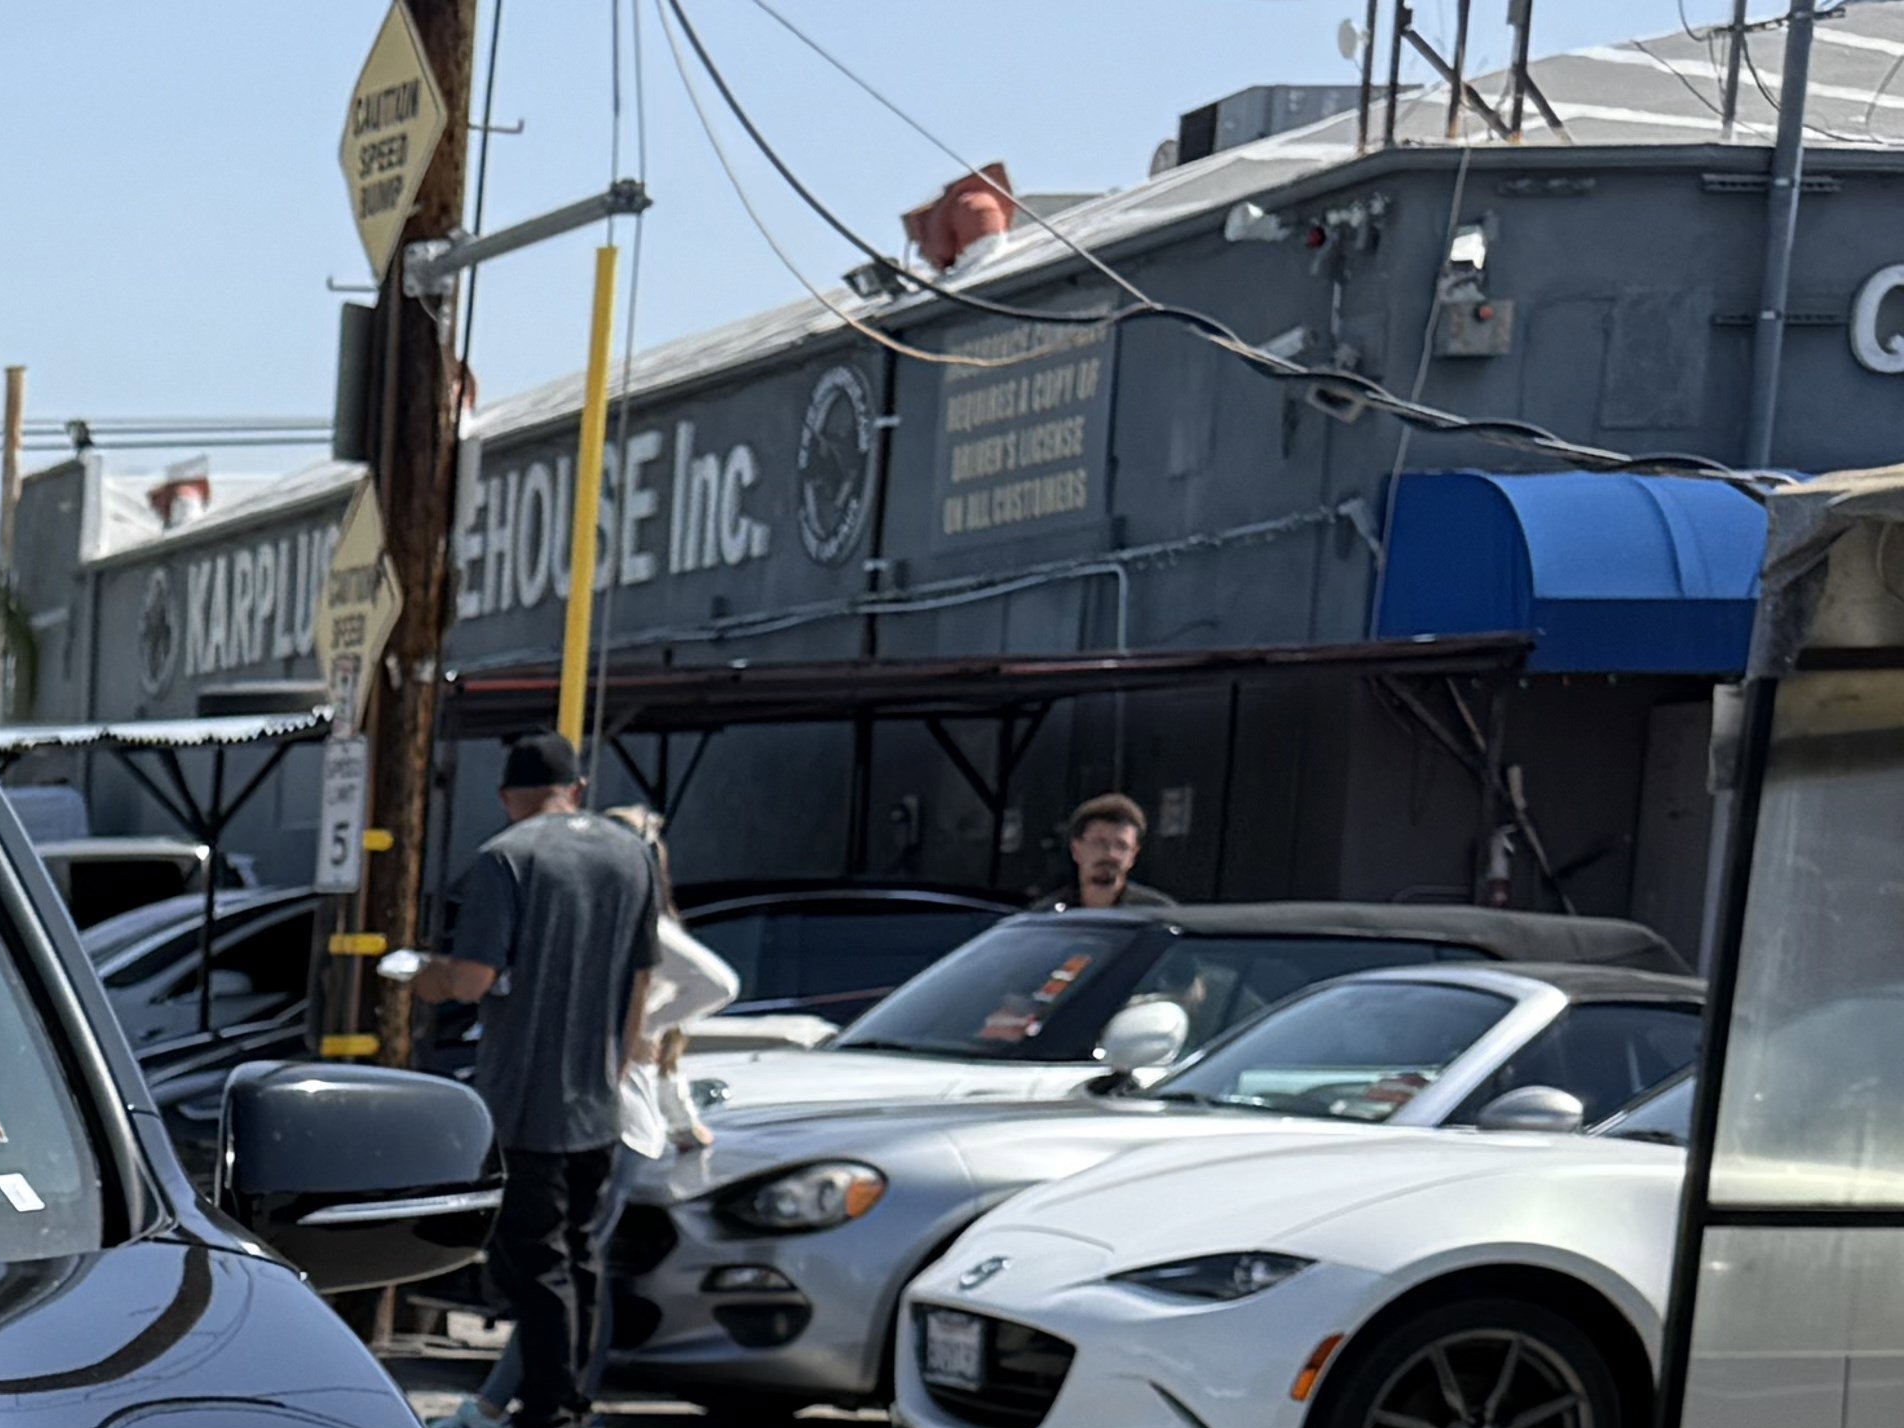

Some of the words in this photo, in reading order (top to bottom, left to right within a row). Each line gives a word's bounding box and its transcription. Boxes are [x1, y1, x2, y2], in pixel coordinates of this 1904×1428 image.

[353, 77, 420, 138] CAUTION
[359, 133, 407, 180] SPEED
[1031, 363, 1075, 412] COPY
[669, 419, 770, 575] Inc.
[330, 821, 350, 867] 5
